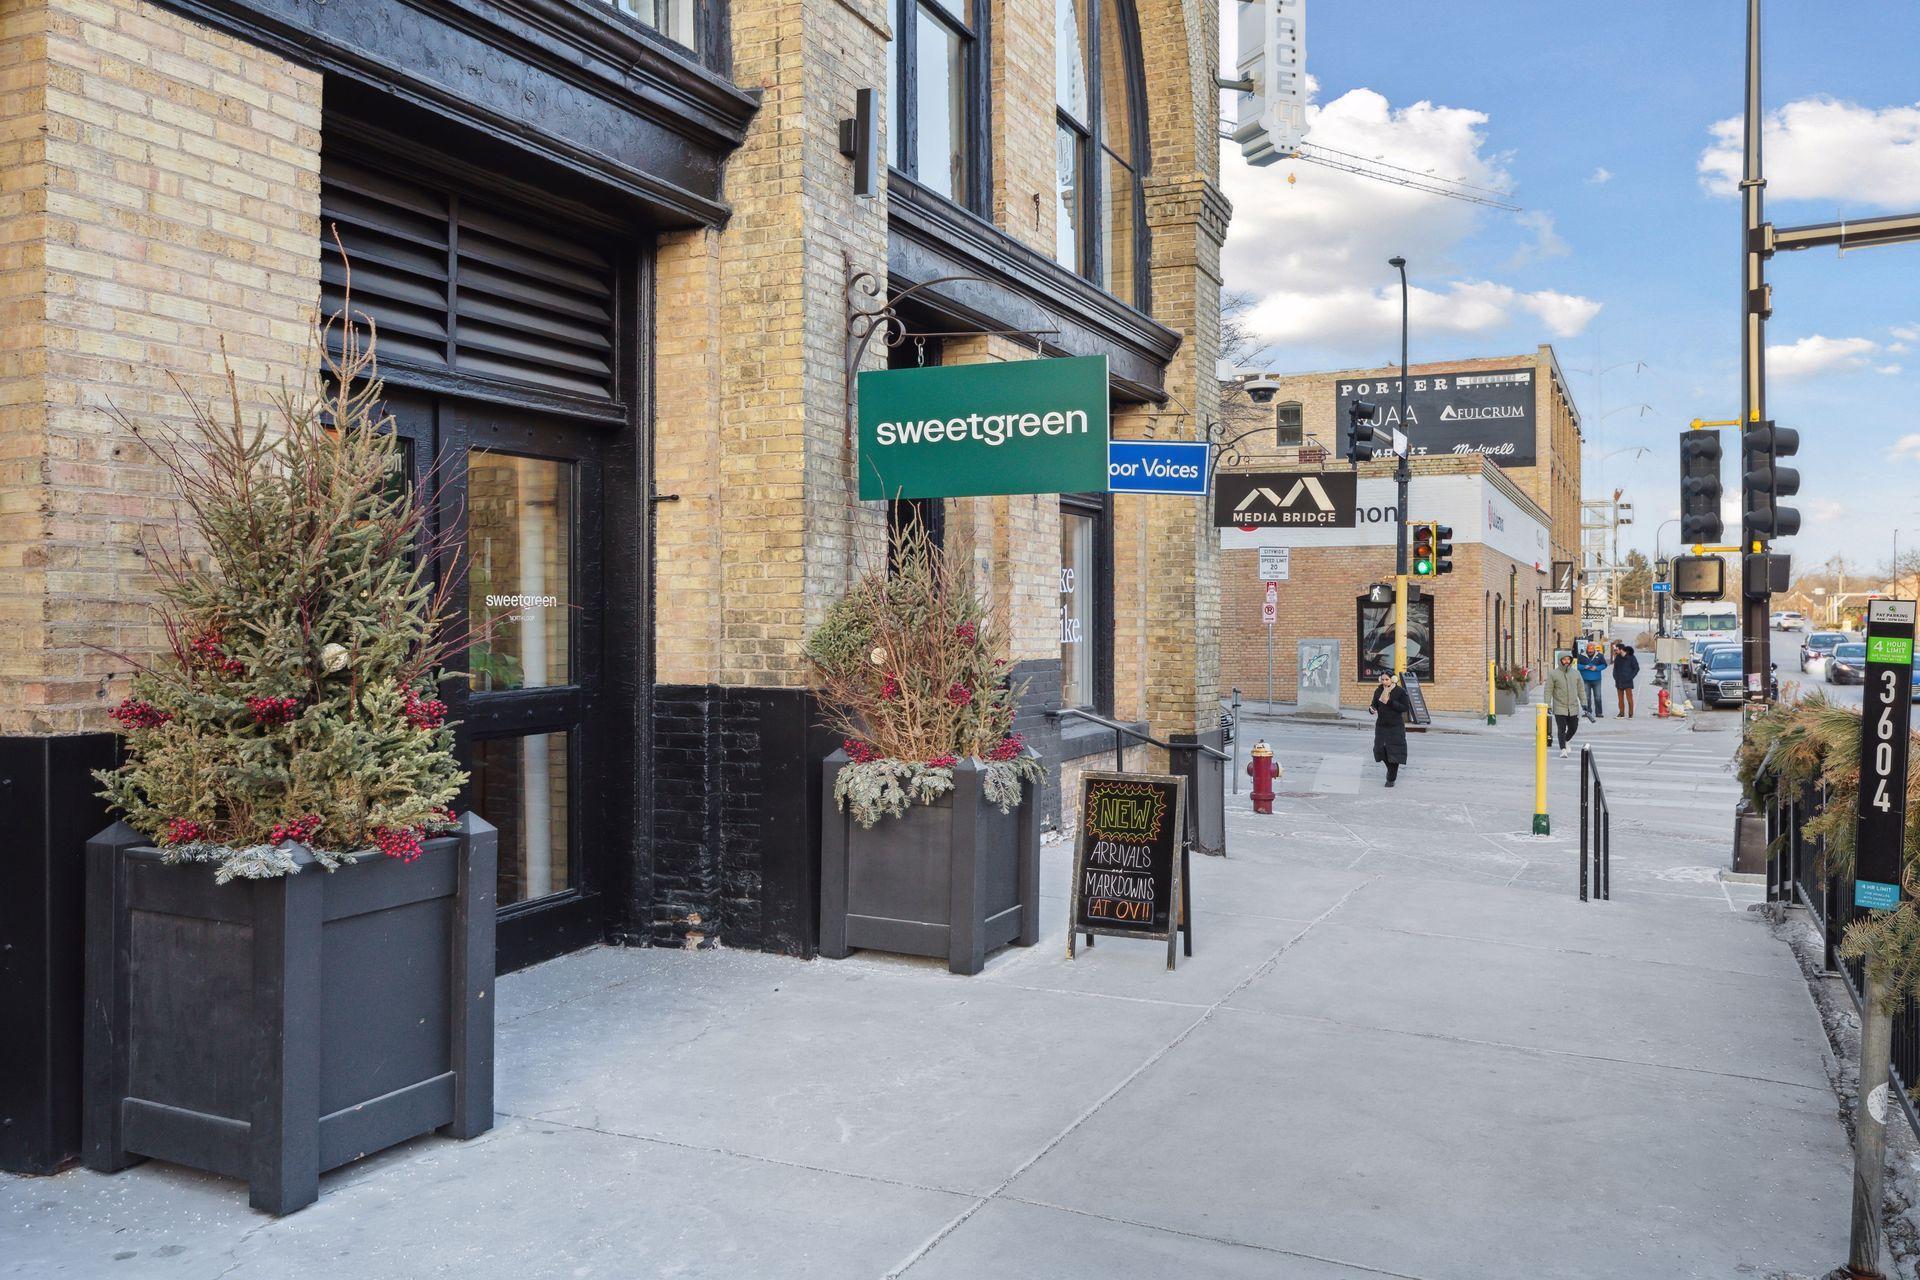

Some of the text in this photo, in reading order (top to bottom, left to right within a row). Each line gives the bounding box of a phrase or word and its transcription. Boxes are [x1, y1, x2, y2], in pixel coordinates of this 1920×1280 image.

[1340, 378, 1449, 397] PORTER
[876, 409, 1088, 446] sweetgreen
[1452, 442, 1515, 455] Madewell
[1141, 457, 1198, 478] Voices
[1232, 511, 1336, 523] MEDIA BRIDGE
[485, 593, 557, 610] sweetgreen
[1873, 641, 1883, 651] 4
[1872, 670, 1897, 813] 3604
[1100, 798, 1152, 830] NEW
[1090, 841, 1152, 868] ARRIVALS
[1085, 871, 1155, 901] MARKDOWNS
[1092, 899, 1111, 916] AT
